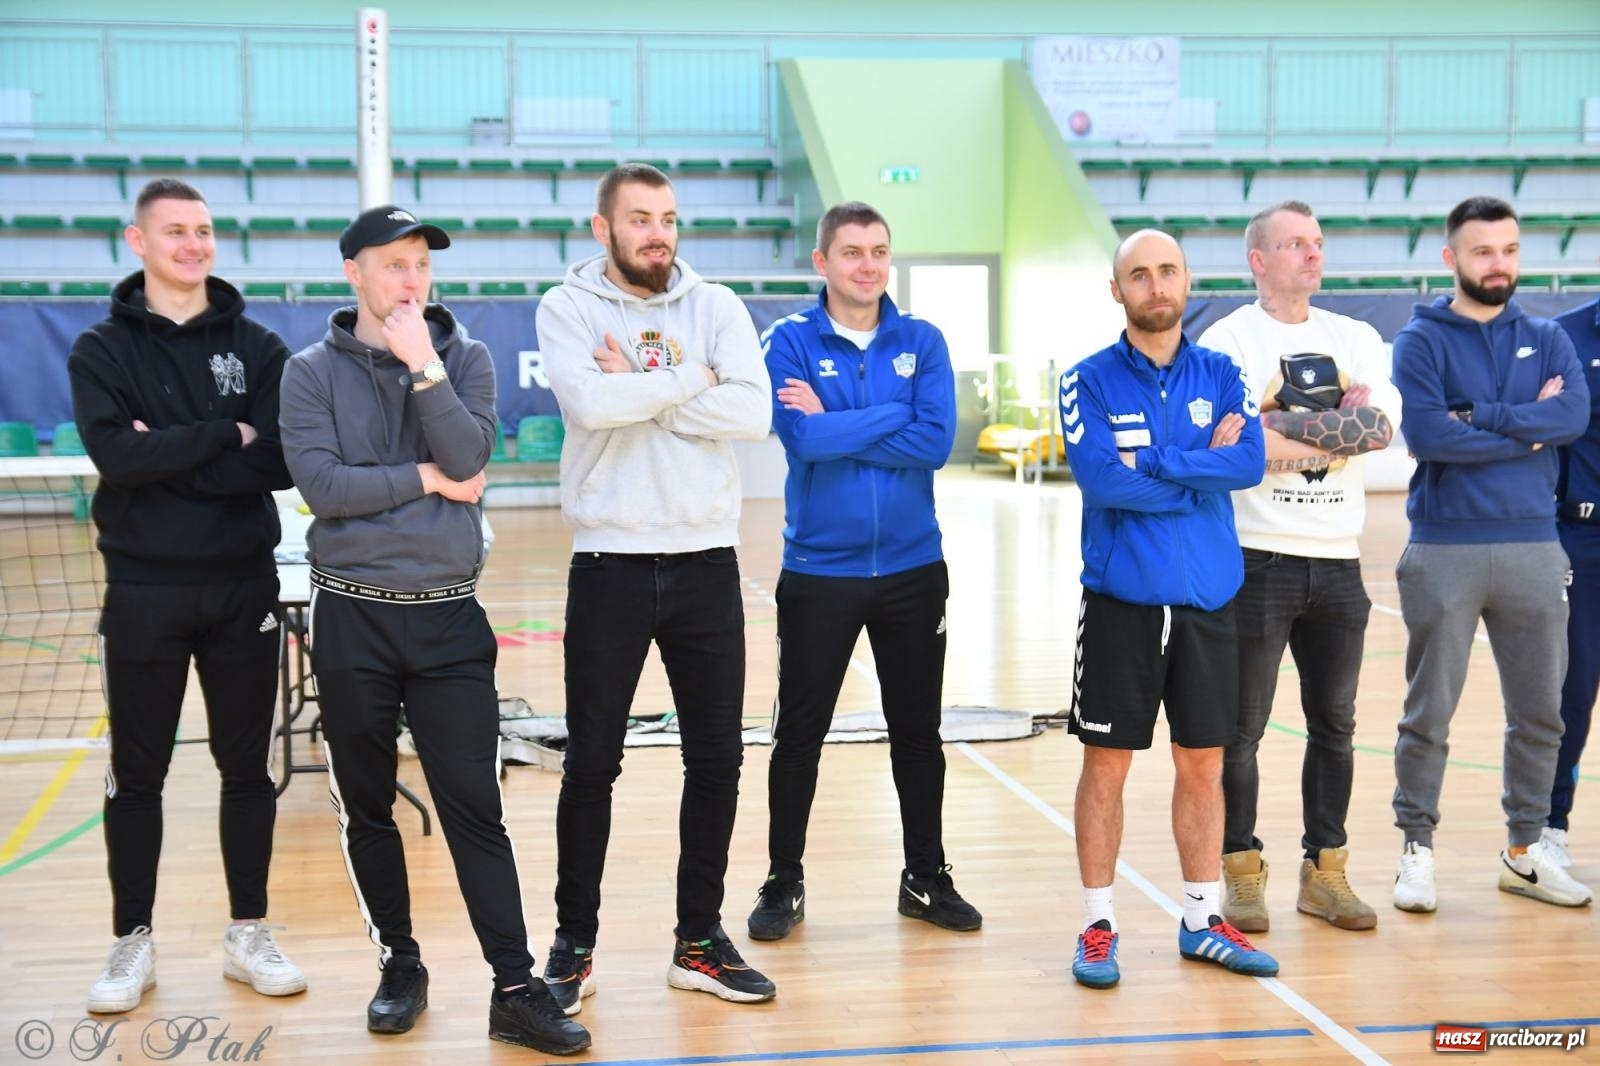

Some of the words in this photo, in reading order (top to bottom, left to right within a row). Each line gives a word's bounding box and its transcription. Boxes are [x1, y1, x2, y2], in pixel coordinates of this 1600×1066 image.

[1052, 41, 1165, 64] MIESZKO
[1579, 502, 1595, 518] 17
[326, 579, 347, 591] SIKSILK
[359, 588, 381, 597] SIKSILK
[428, 590, 448, 598] SIKSILK
[1079, 716, 1112, 734] hummel
